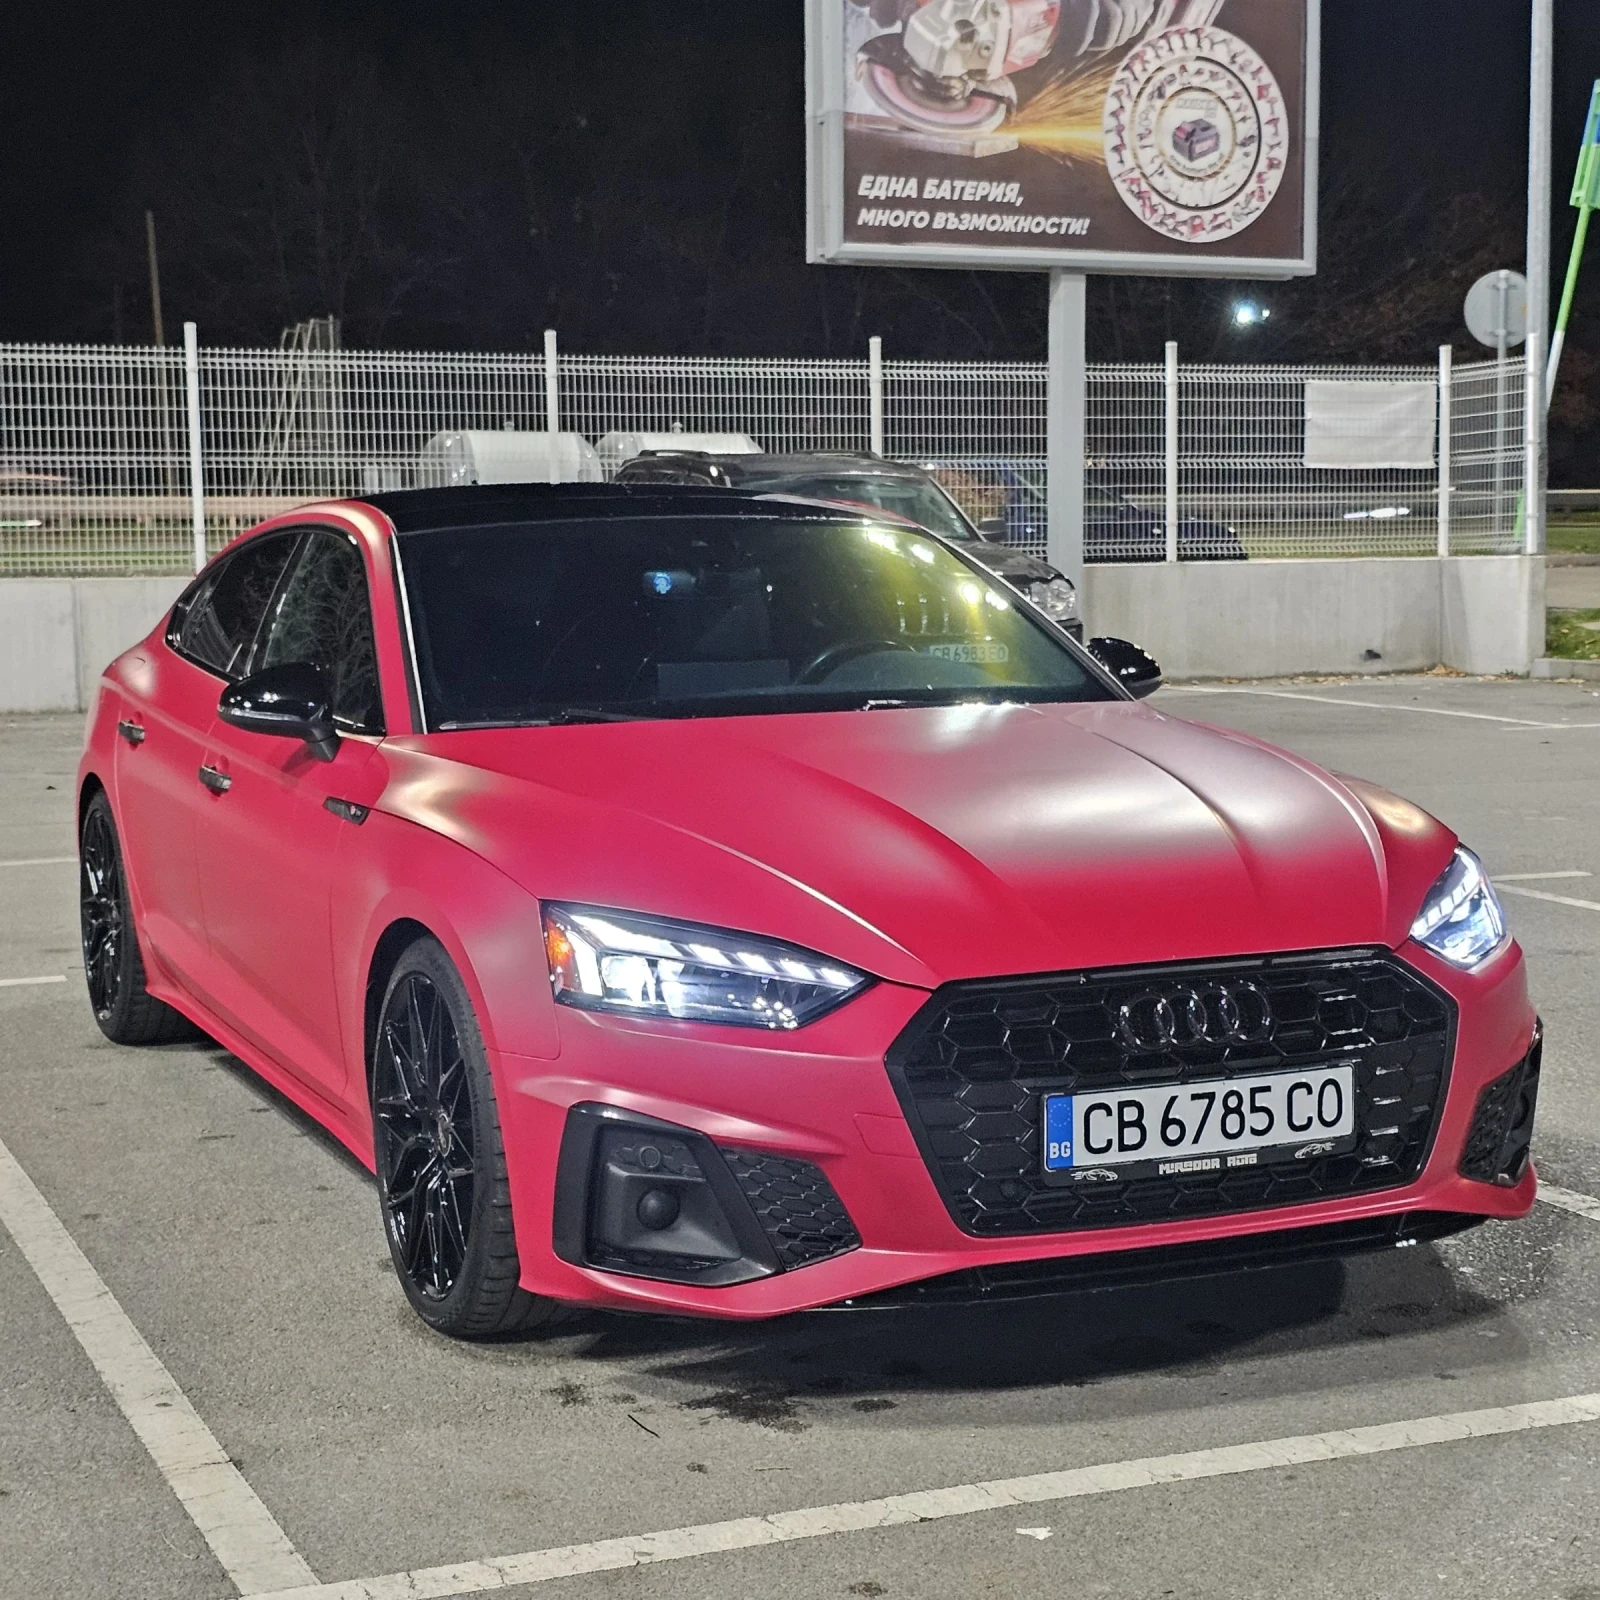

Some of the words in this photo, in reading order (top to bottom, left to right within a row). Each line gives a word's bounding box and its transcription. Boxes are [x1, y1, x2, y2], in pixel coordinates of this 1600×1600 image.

[858, 174, 918, 200] ЕДНА
[922, 177, 1024, 207] БАТЕРИЯ,
[857, 208, 930, 230] МНОГО
[932, 211, 1091, 236] ВЪЗМОЖНОСТИ!
[1083, 1099, 1147, 1155] CB
[1159, 1085, 1275, 1148] 6785
[1286, 1077, 1343, 1132] CO
[1049, 1141, 1071, 1159] BG
